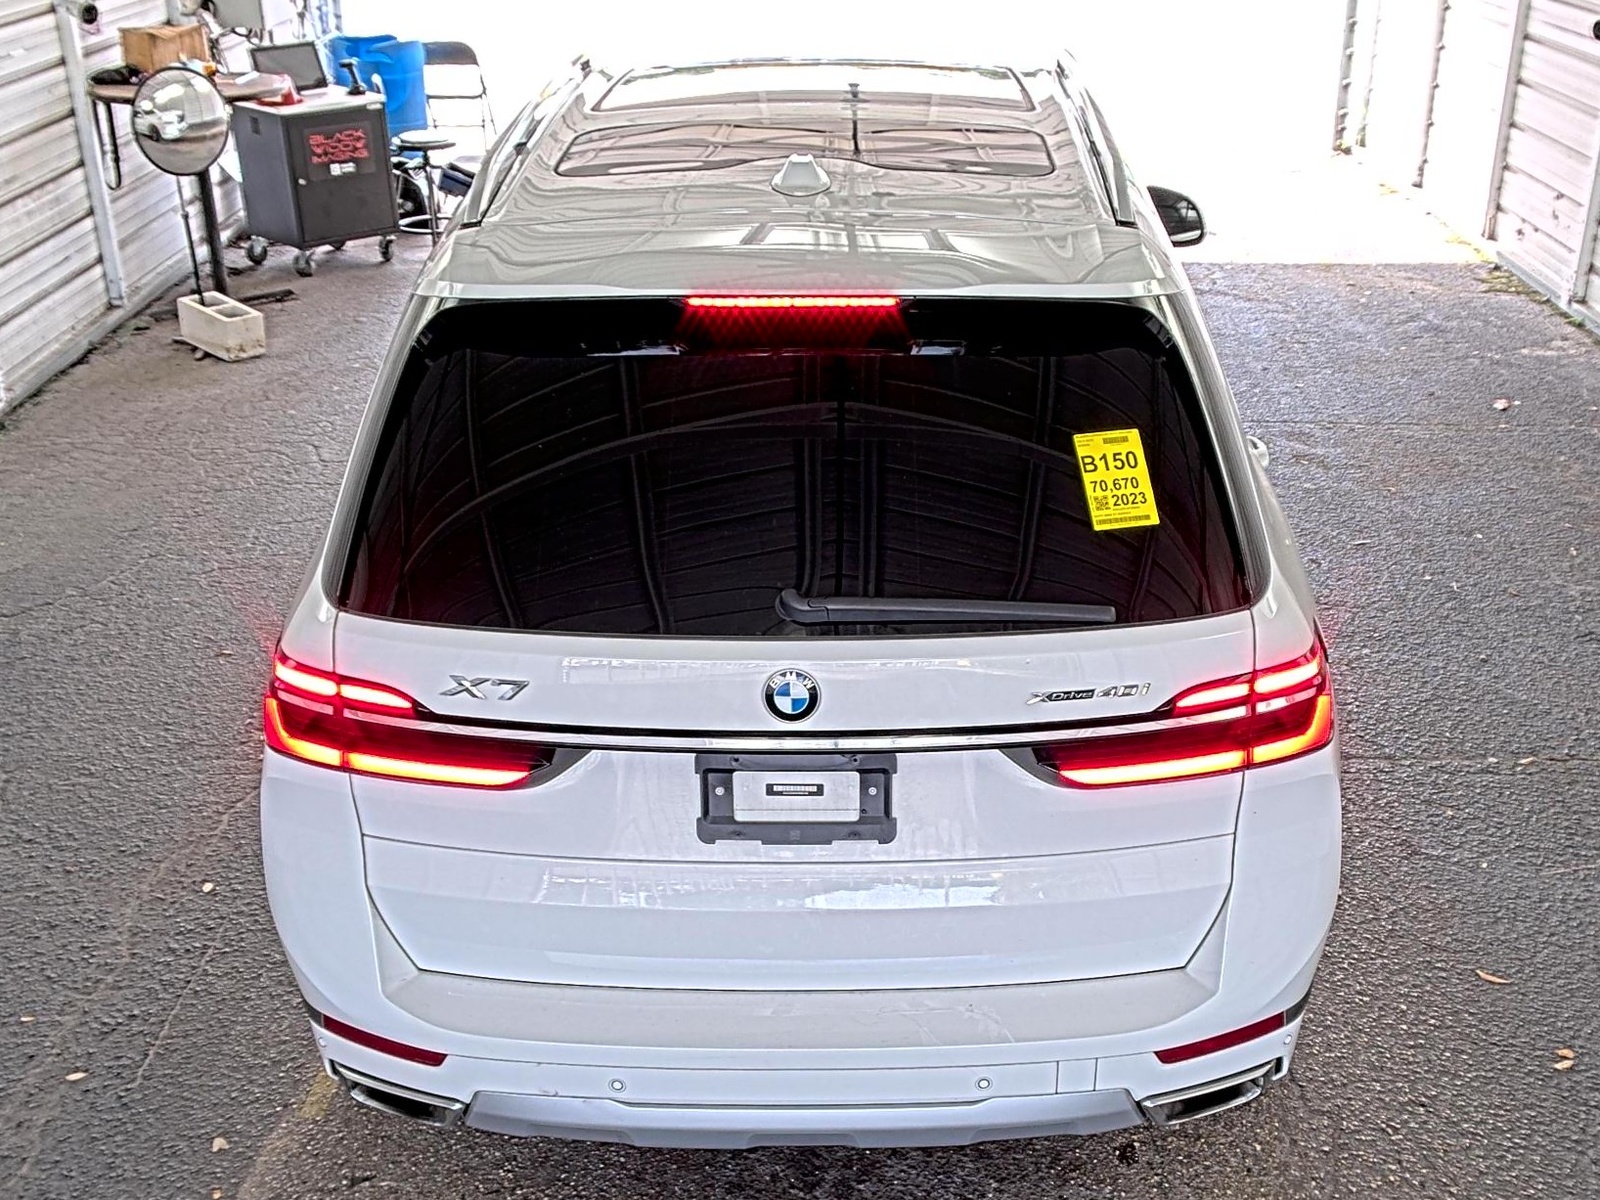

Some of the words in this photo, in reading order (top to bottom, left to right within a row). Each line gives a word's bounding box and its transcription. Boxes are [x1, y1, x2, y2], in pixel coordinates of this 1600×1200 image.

[1080, 450, 1138, 473] B150
[1089, 476, 1139, 493] 70,670
[1111, 492, 1147, 507] 2023
[439, 674, 530, 701] X7
[769, 671, 815, 689] BMW
[1097, 682, 1151, 699] 40i
